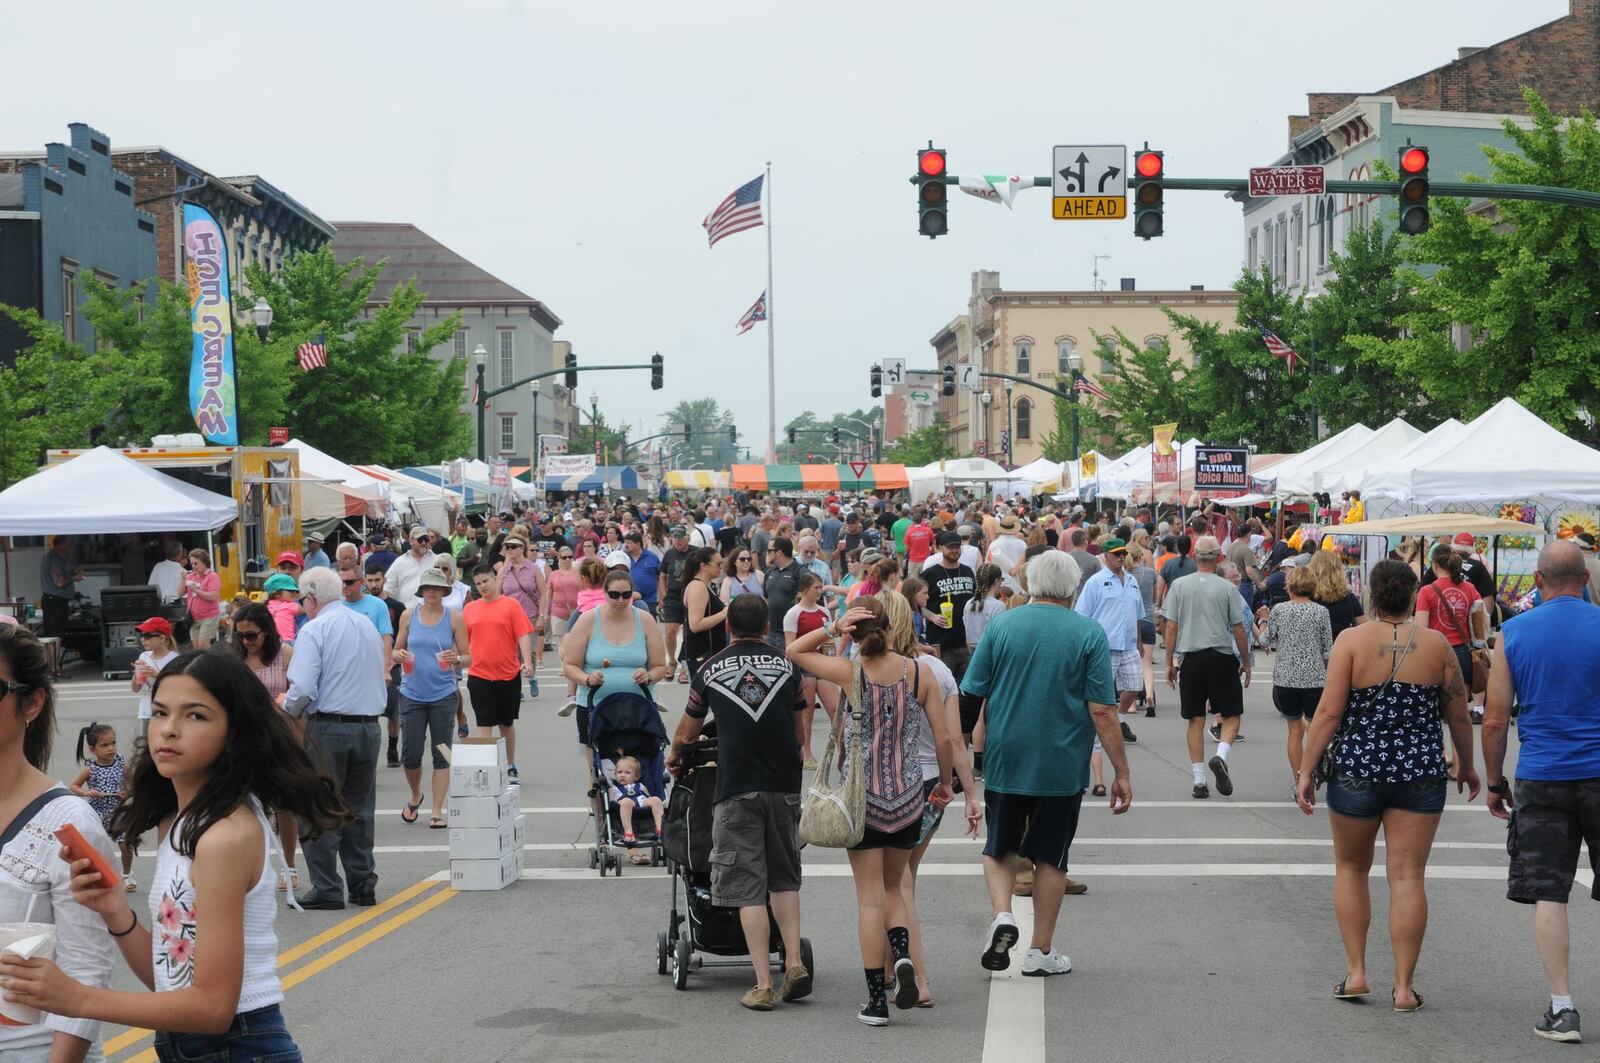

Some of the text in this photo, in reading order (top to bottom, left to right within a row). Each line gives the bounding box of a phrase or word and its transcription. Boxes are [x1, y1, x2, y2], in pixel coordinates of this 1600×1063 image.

[1253, 174, 1321, 189] WATER ST
[1062, 199, 1117, 216] AHEAD
[1208, 451, 1233, 464] BBQ
[1200, 464, 1243, 473] ULTIMATE
[1197, 471, 1245, 484] Spice Rubs
[936, 577, 953, 588] OLD
[939, 582, 965, 593] NEVER
[703, 654, 793, 684] AMERICAN
[450, 808, 461, 817] ESV
[453, 872, 464, 880] ESV
